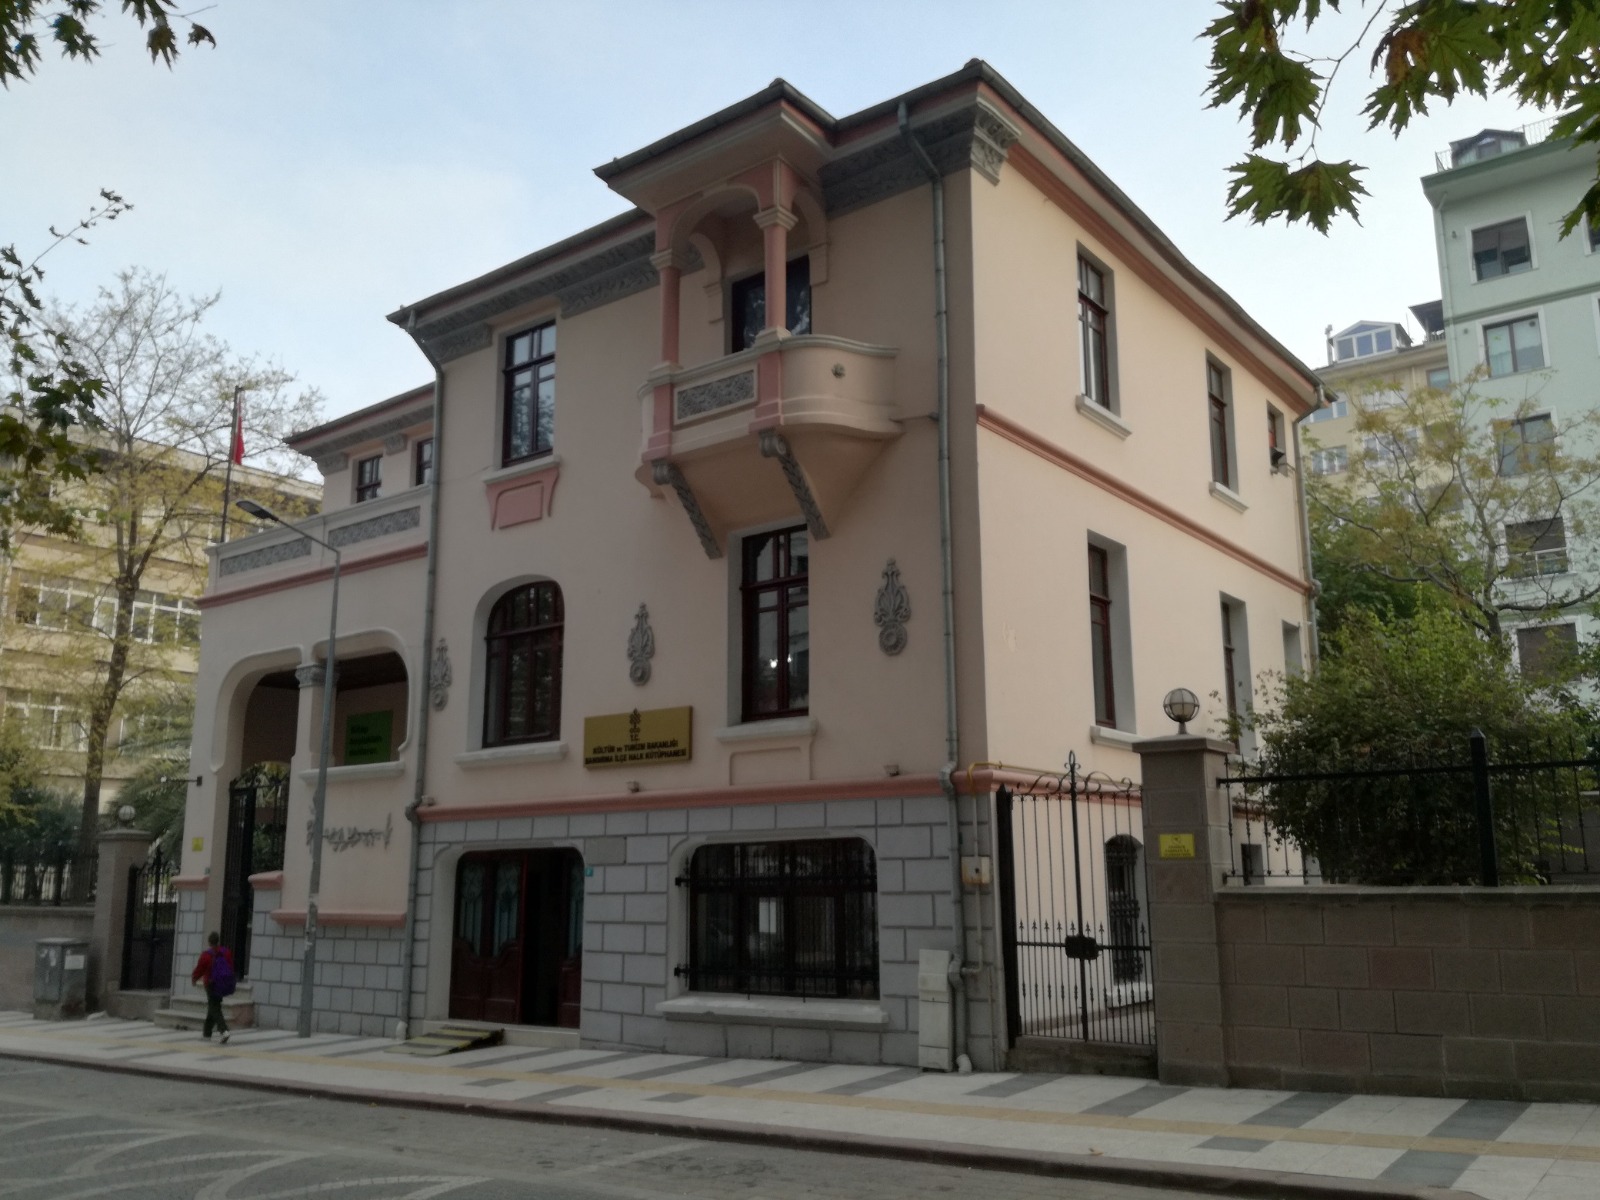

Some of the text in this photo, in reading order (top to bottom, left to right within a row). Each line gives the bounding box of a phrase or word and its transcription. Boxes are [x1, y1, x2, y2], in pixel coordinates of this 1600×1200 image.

[593, 745, 615, 755] KÜLTÜR
[647, 738, 678, 750] BAKANLIĞI
[615, 753, 627, 764] İLÇE
[629, 753, 643, 761] HALK
